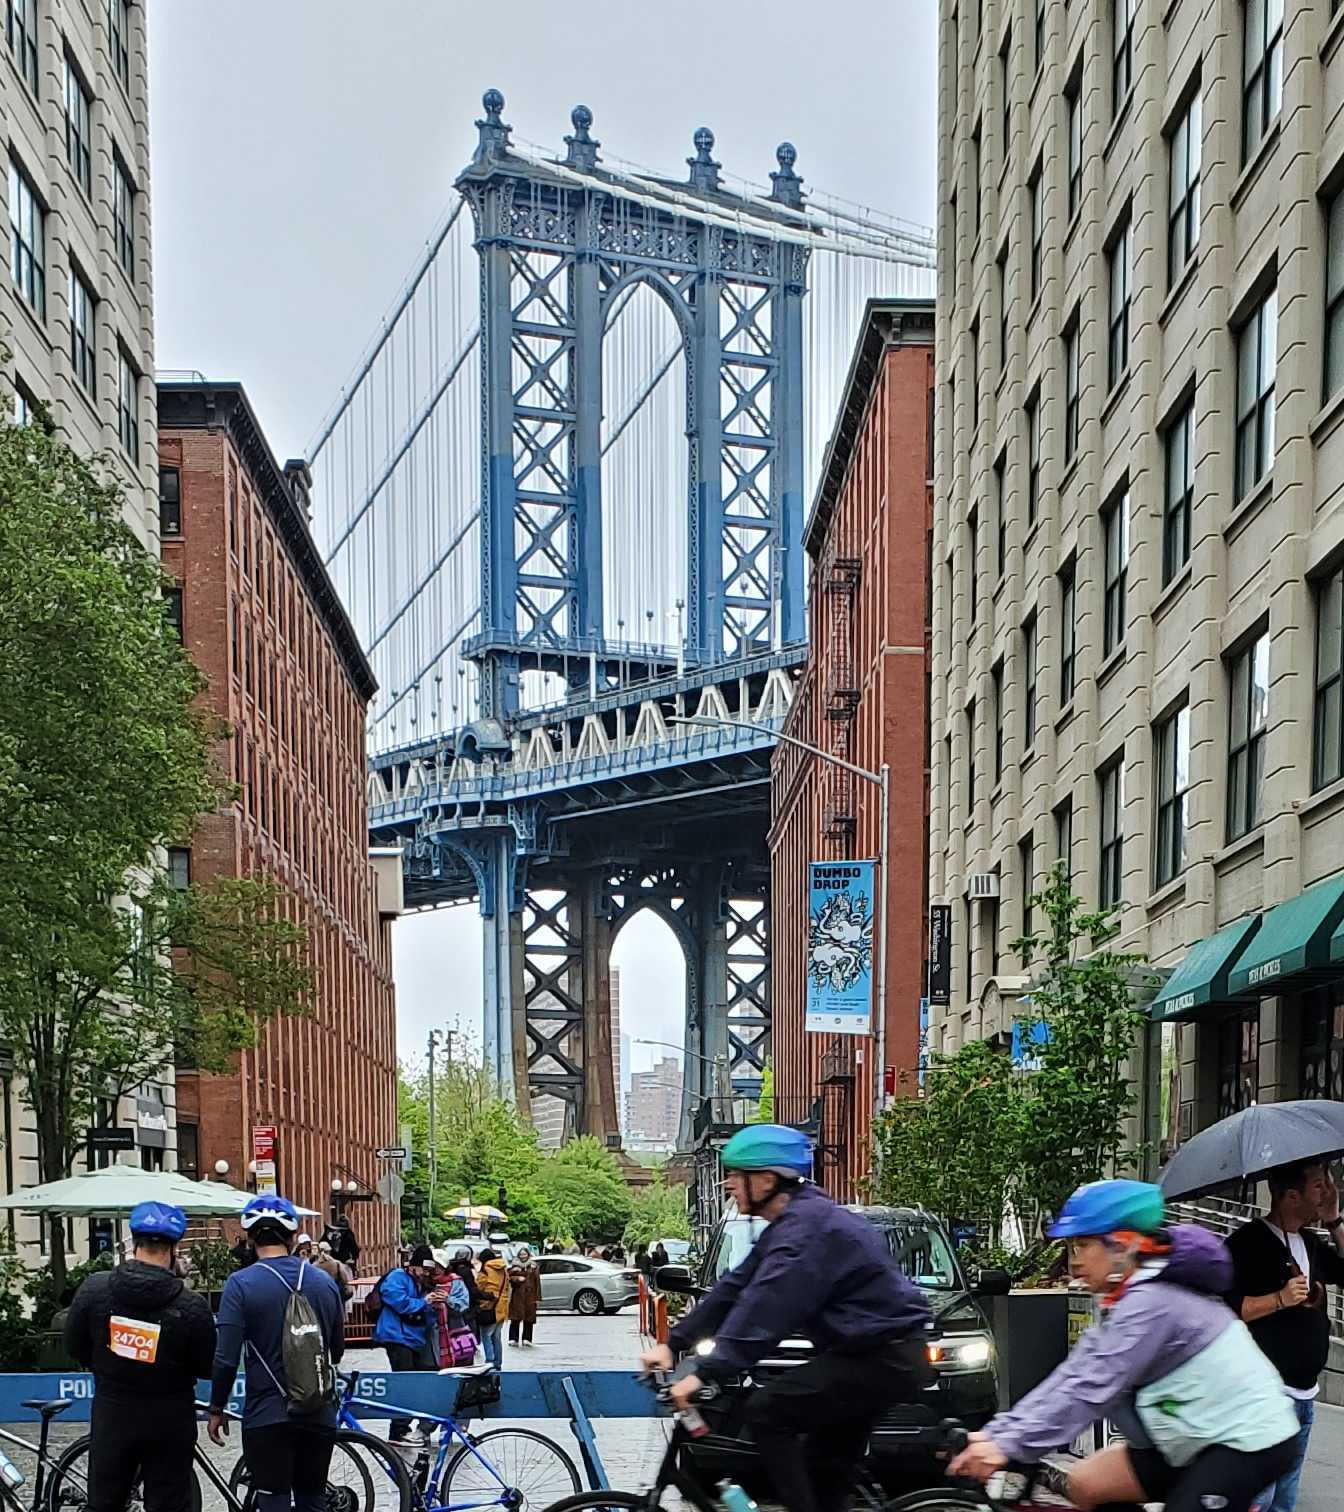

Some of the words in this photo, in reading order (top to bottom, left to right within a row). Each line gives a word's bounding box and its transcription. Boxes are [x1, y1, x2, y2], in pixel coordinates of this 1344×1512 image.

[813, 867, 861, 878] DUMBO
[813, 880, 850, 890] DROP
[113, 1330, 154, 1350] 24704
[59, 1378, 94, 1399] POL
